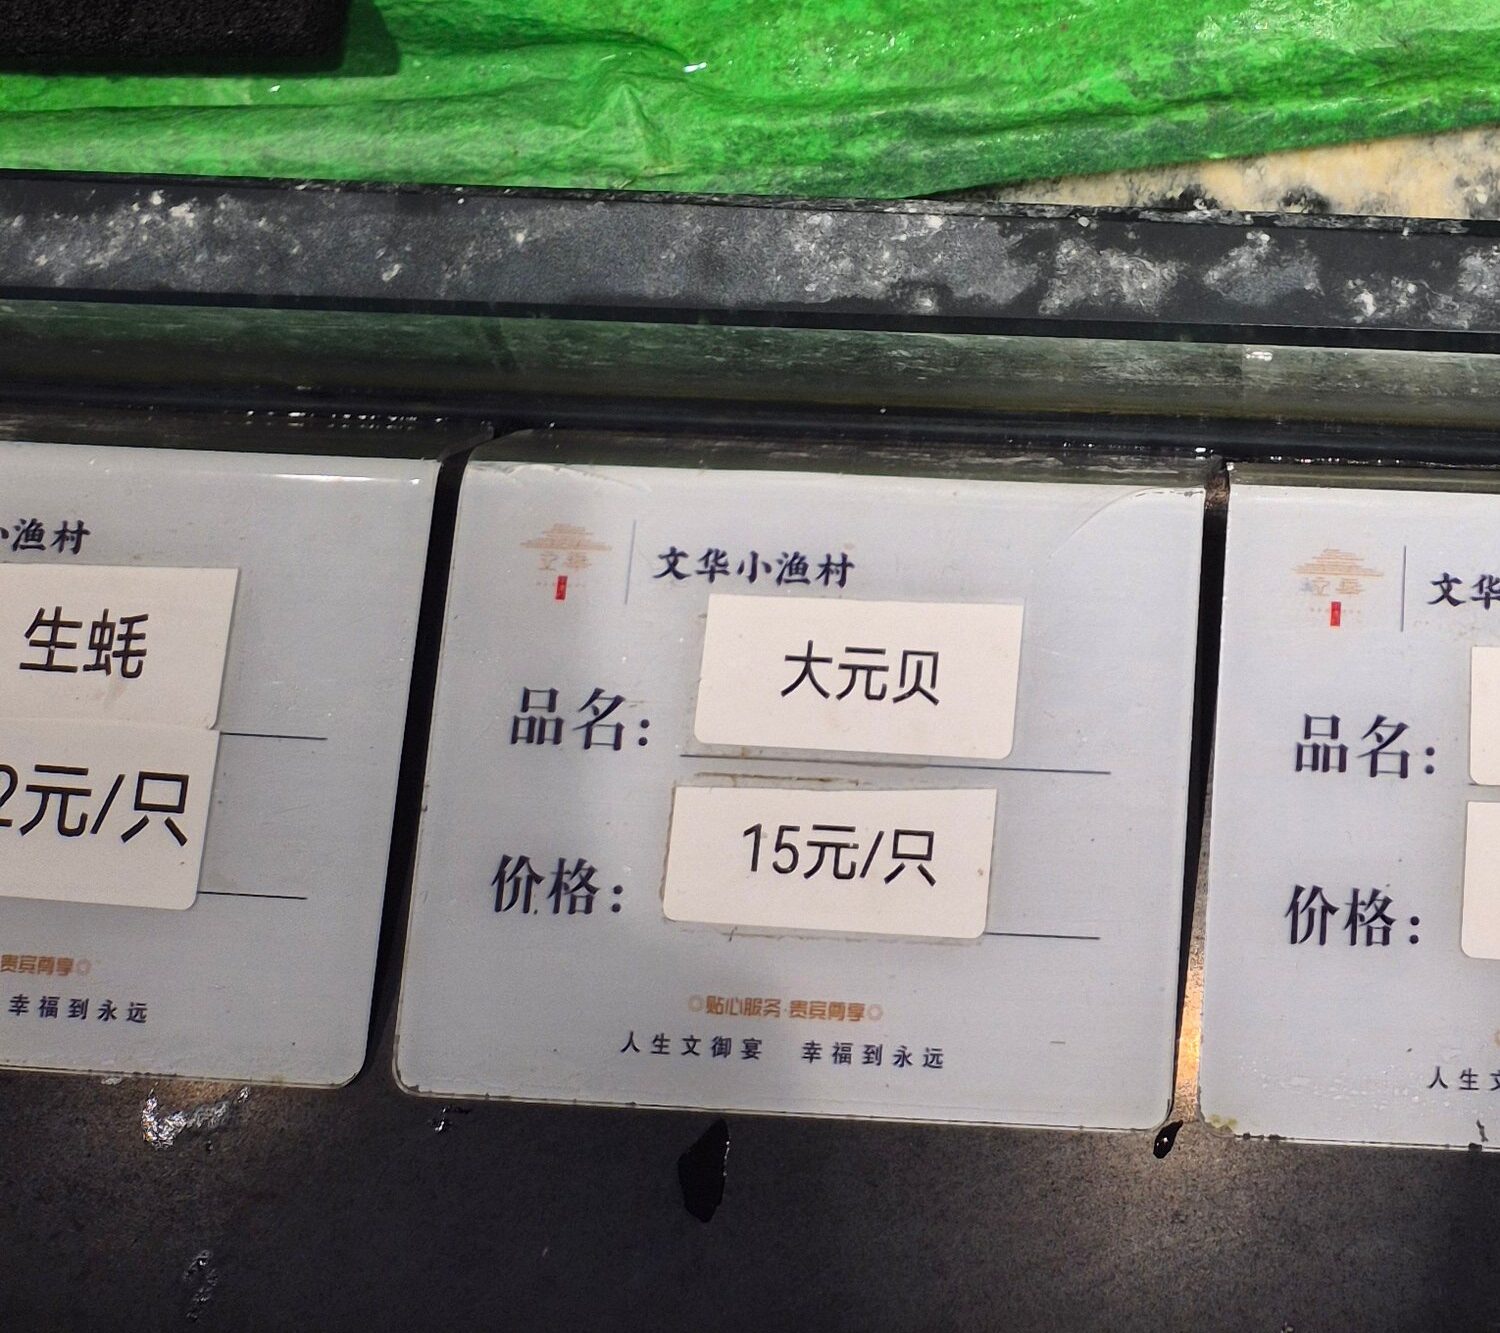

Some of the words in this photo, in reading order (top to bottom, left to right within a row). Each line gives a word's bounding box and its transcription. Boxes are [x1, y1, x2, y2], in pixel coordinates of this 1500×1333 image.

[654, 547, 855, 589] 文华小渔村
[19, 606, 149, 679] 生蚝
[781, 639, 940, 706] 大元贝
[744, 823, 937, 887] 15元/只
[8, 994, 148, 1023] 幸福到永远
[621, 1031, 762, 1060] 人生文御宴
[802, 1040, 944, 1069] 幸福到永远
